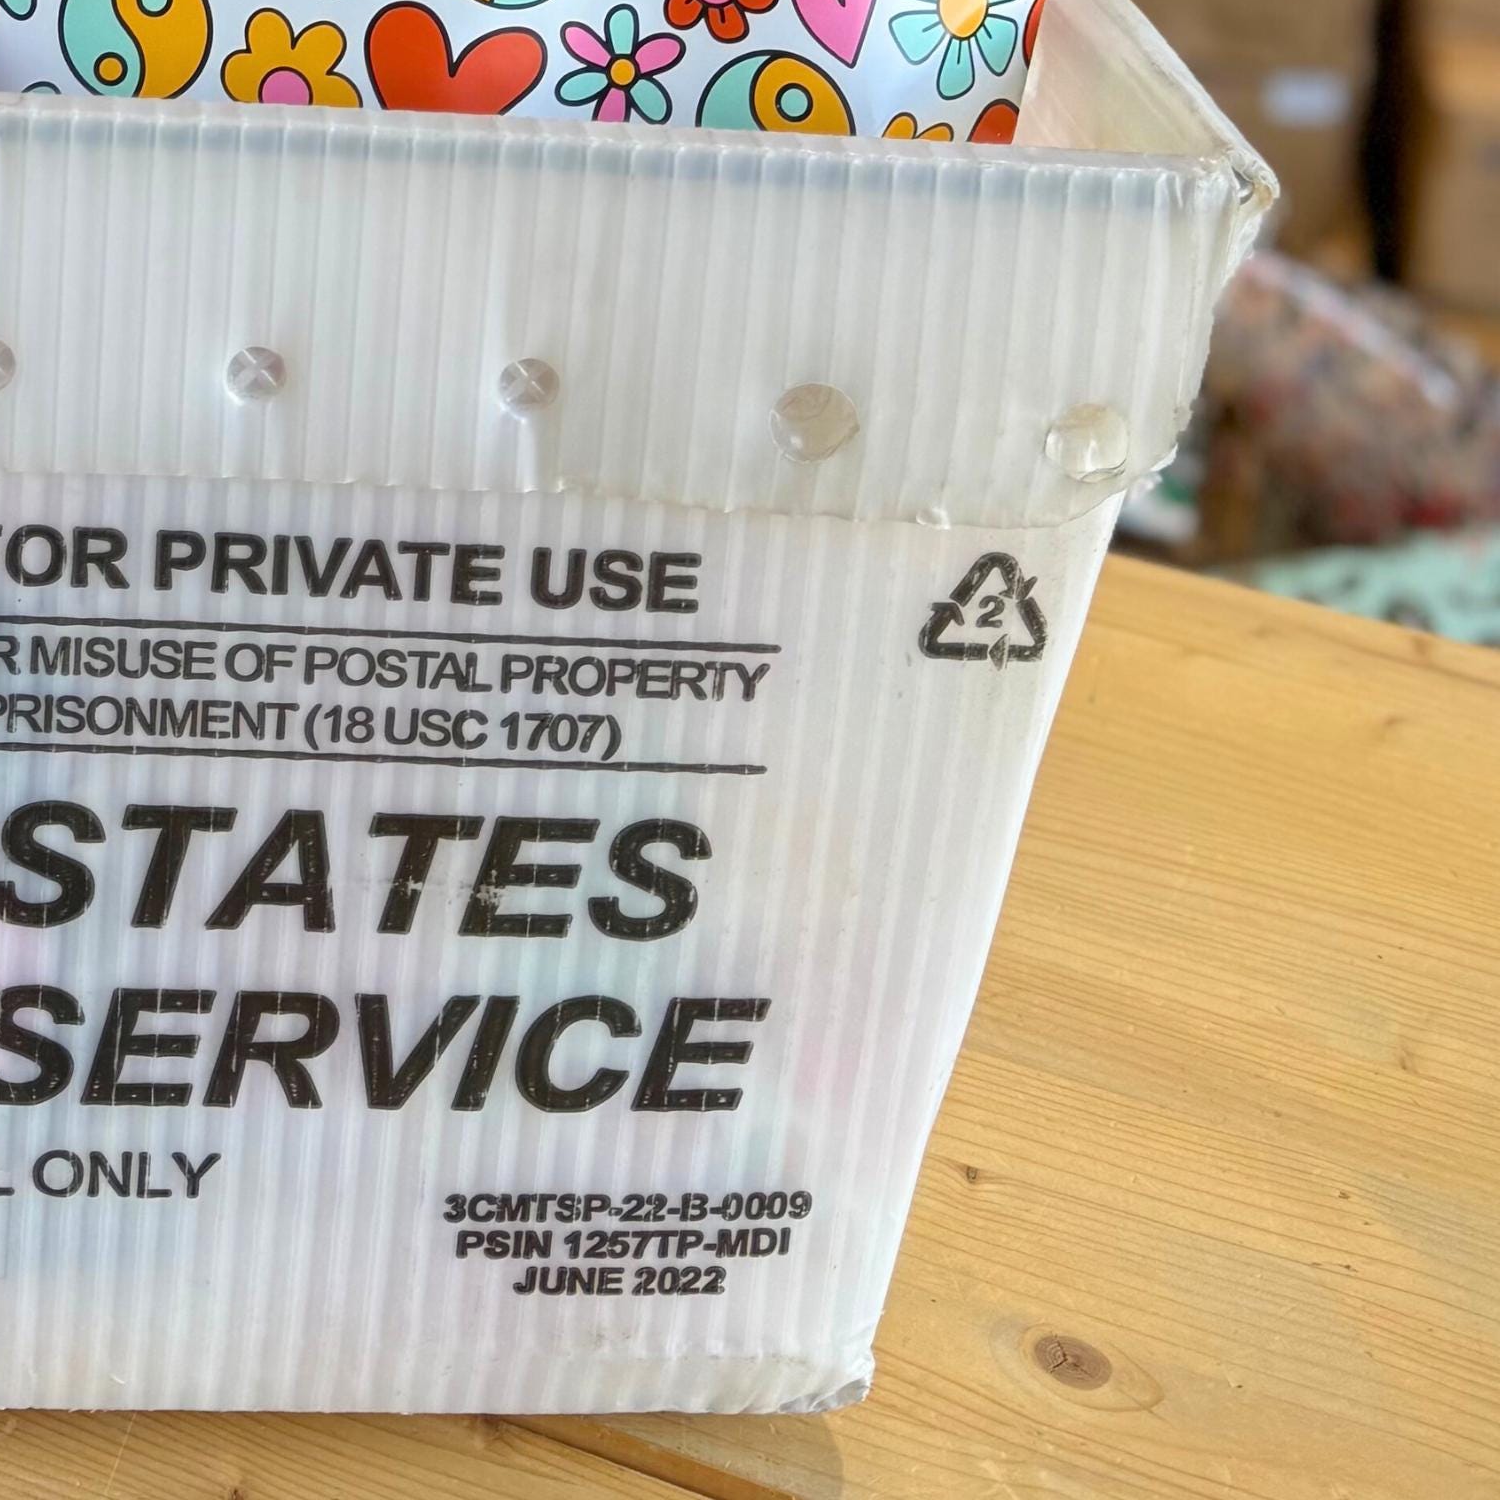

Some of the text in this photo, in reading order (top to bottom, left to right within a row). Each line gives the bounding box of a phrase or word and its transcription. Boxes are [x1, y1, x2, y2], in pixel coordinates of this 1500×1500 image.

[154, 529, 505, 606] PRIVATE
[530, 546, 702, 613] USE
[976, 595, 1005, 628] 2
[30, 635, 218, 681] MISUSE
[225, 642, 297, 683] OF
[303, 645, 492, 692] POSTAL
[500, 653, 771, 701] PROPERTY
[304, 703, 375, 751] (18
[383, 707, 489, 750] USC
[500, 711, 623, 761] 1707)
[32, 1148, 222, 1201] ONLY
[443, 1191, 813, 1224] 3CMTSP-22-B-0009
[455, 1227, 792, 1260] PSIN 1257TP-MDI
[513, 1266, 728, 1296] JUNE 2022
